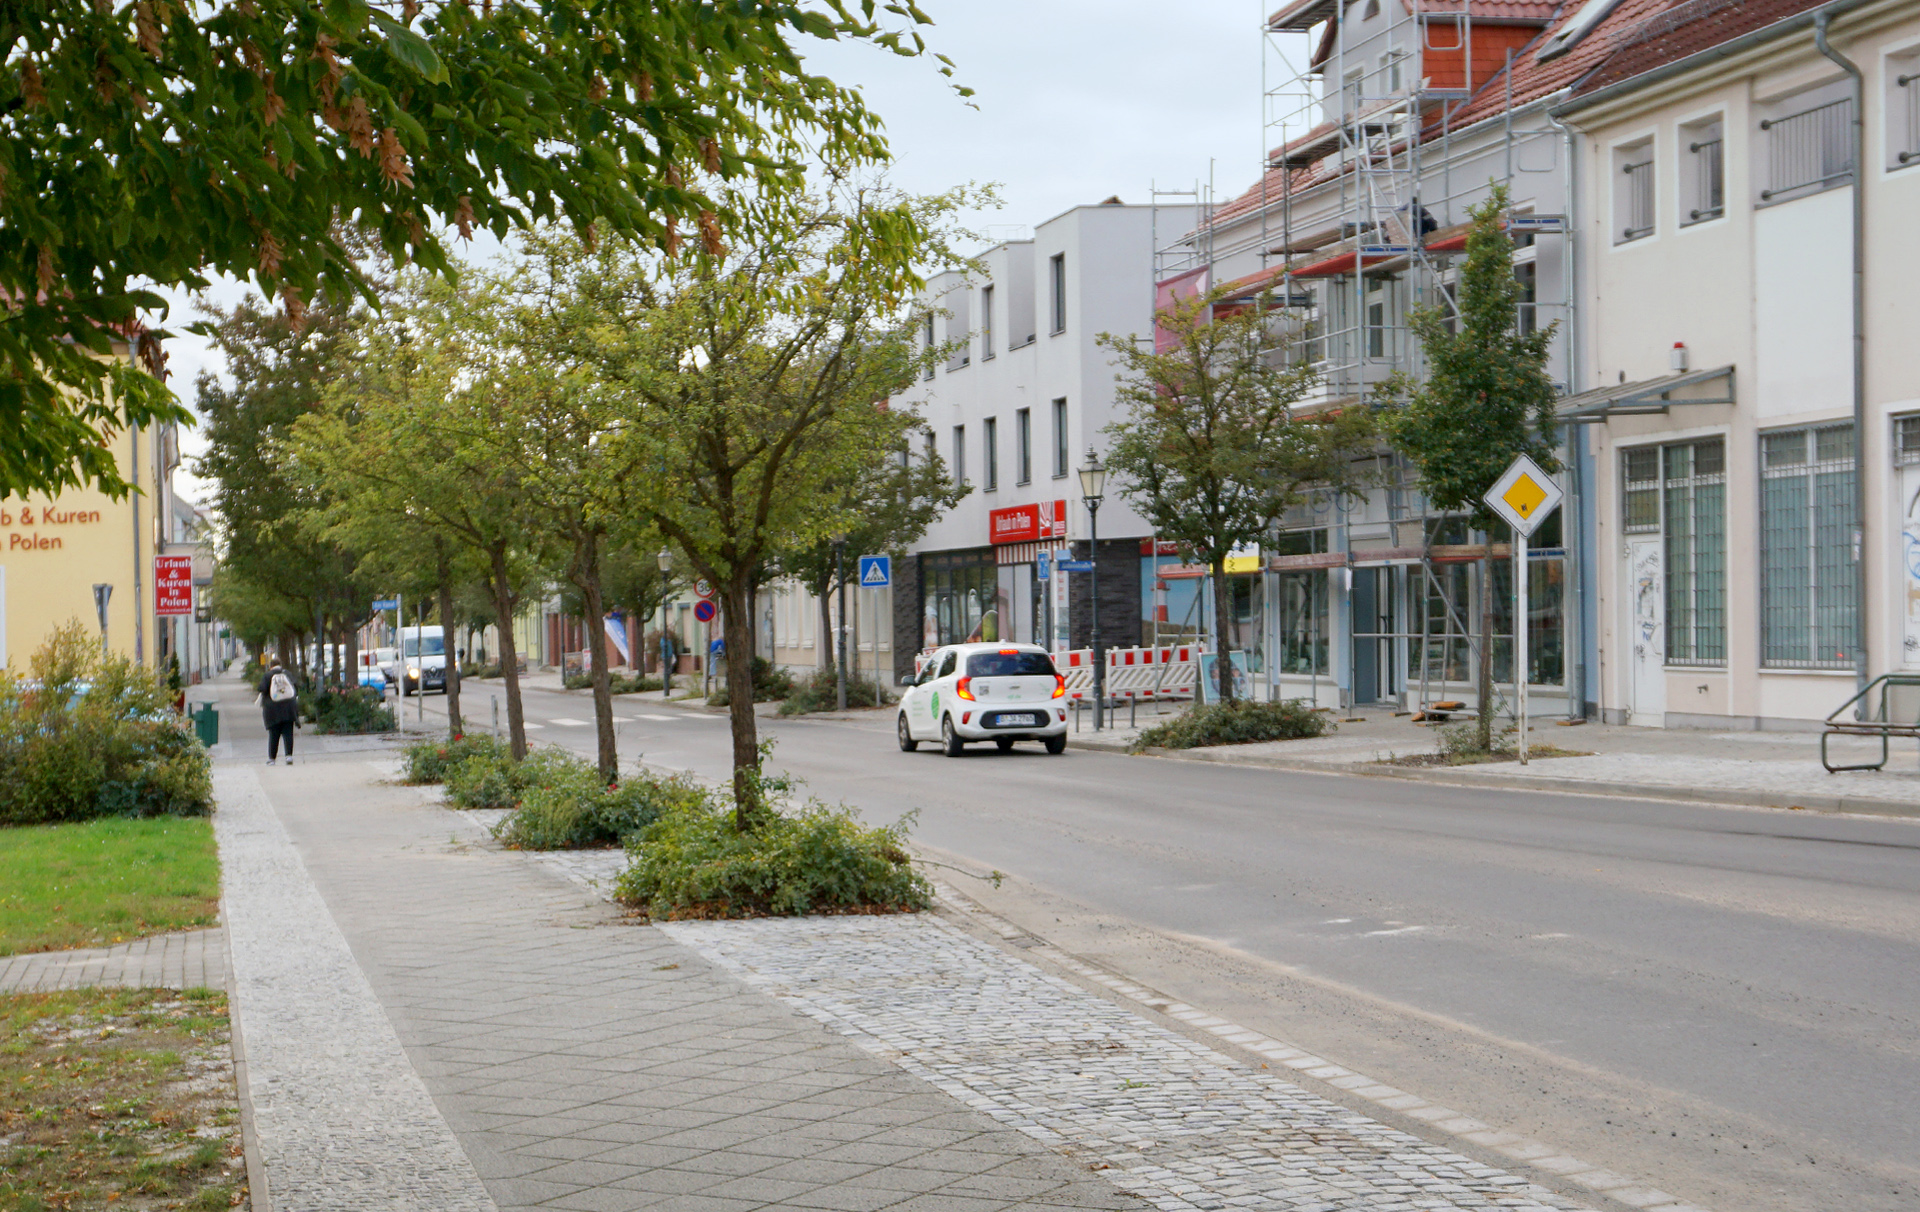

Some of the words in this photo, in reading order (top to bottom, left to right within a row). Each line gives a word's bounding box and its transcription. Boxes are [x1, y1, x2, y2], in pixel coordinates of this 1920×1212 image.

[20, 507, 34, 526] &
[43, 506, 100, 525] Kuren
[996, 514, 1011, 532] Urlaub
[1016, 512, 1031, 529] Polen
[10, 532, 62, 551] Polen
[156, 559, 191, 568] Urlaub
[169, 569, 179, 579] &
[158, 578, 190, 587] Kuren
[169, 586, 180, 596] in
[160, 597, 189, 607] Polen
